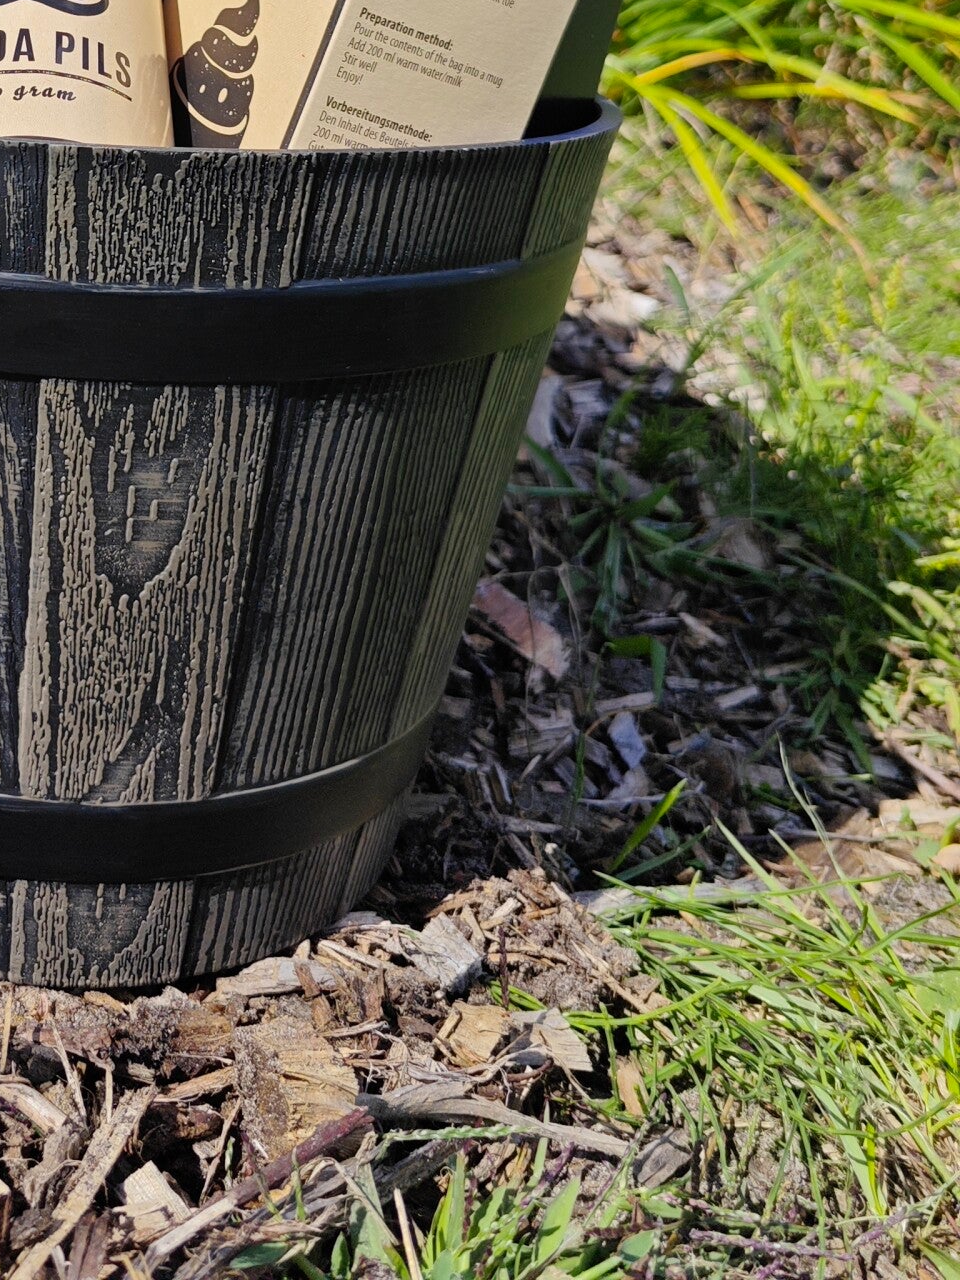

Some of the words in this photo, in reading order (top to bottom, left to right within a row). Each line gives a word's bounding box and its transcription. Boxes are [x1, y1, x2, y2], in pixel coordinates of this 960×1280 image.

[359, 7, 414, 37] Preparation
[415, 29, 453, 51] method:
[54, 30, 132, 88] PILS
[337, 66, 363, 85] Enjoy!
[342, 51, 358, 66] Stir
[359, 59, 377, 72] well
[347, 37, 365, 52] Add
[366, 44, 382, 58] 200
[383, 50, 396, 62] ml
[396, 56, 419, 72] warm
[420, 65, 463, 88] water/milk
[354, 22, 373, 38] Pour
[375, 31, 389, 43] the
[390, 37, 423, 57] contents
[424, 49, 435, 60] of
[435, 52, 448, 65] the
[449, 57, 464, 74] bag
[463, 64, 479, 78] into
[486, 74, 503, 88] mug
[12, 85, 77, 102] gram
[313, 126, 331, 139] 200
[331, 133, 344, 144] ml
[320, 110, 337, 125] Den
[338, 118, 363, 134] Inhalt
[364, 127, 378, 140] des
[380, 132, 409, 148] Beutels
[326, 95, 432, 142] Vorbereitungsmethode:
